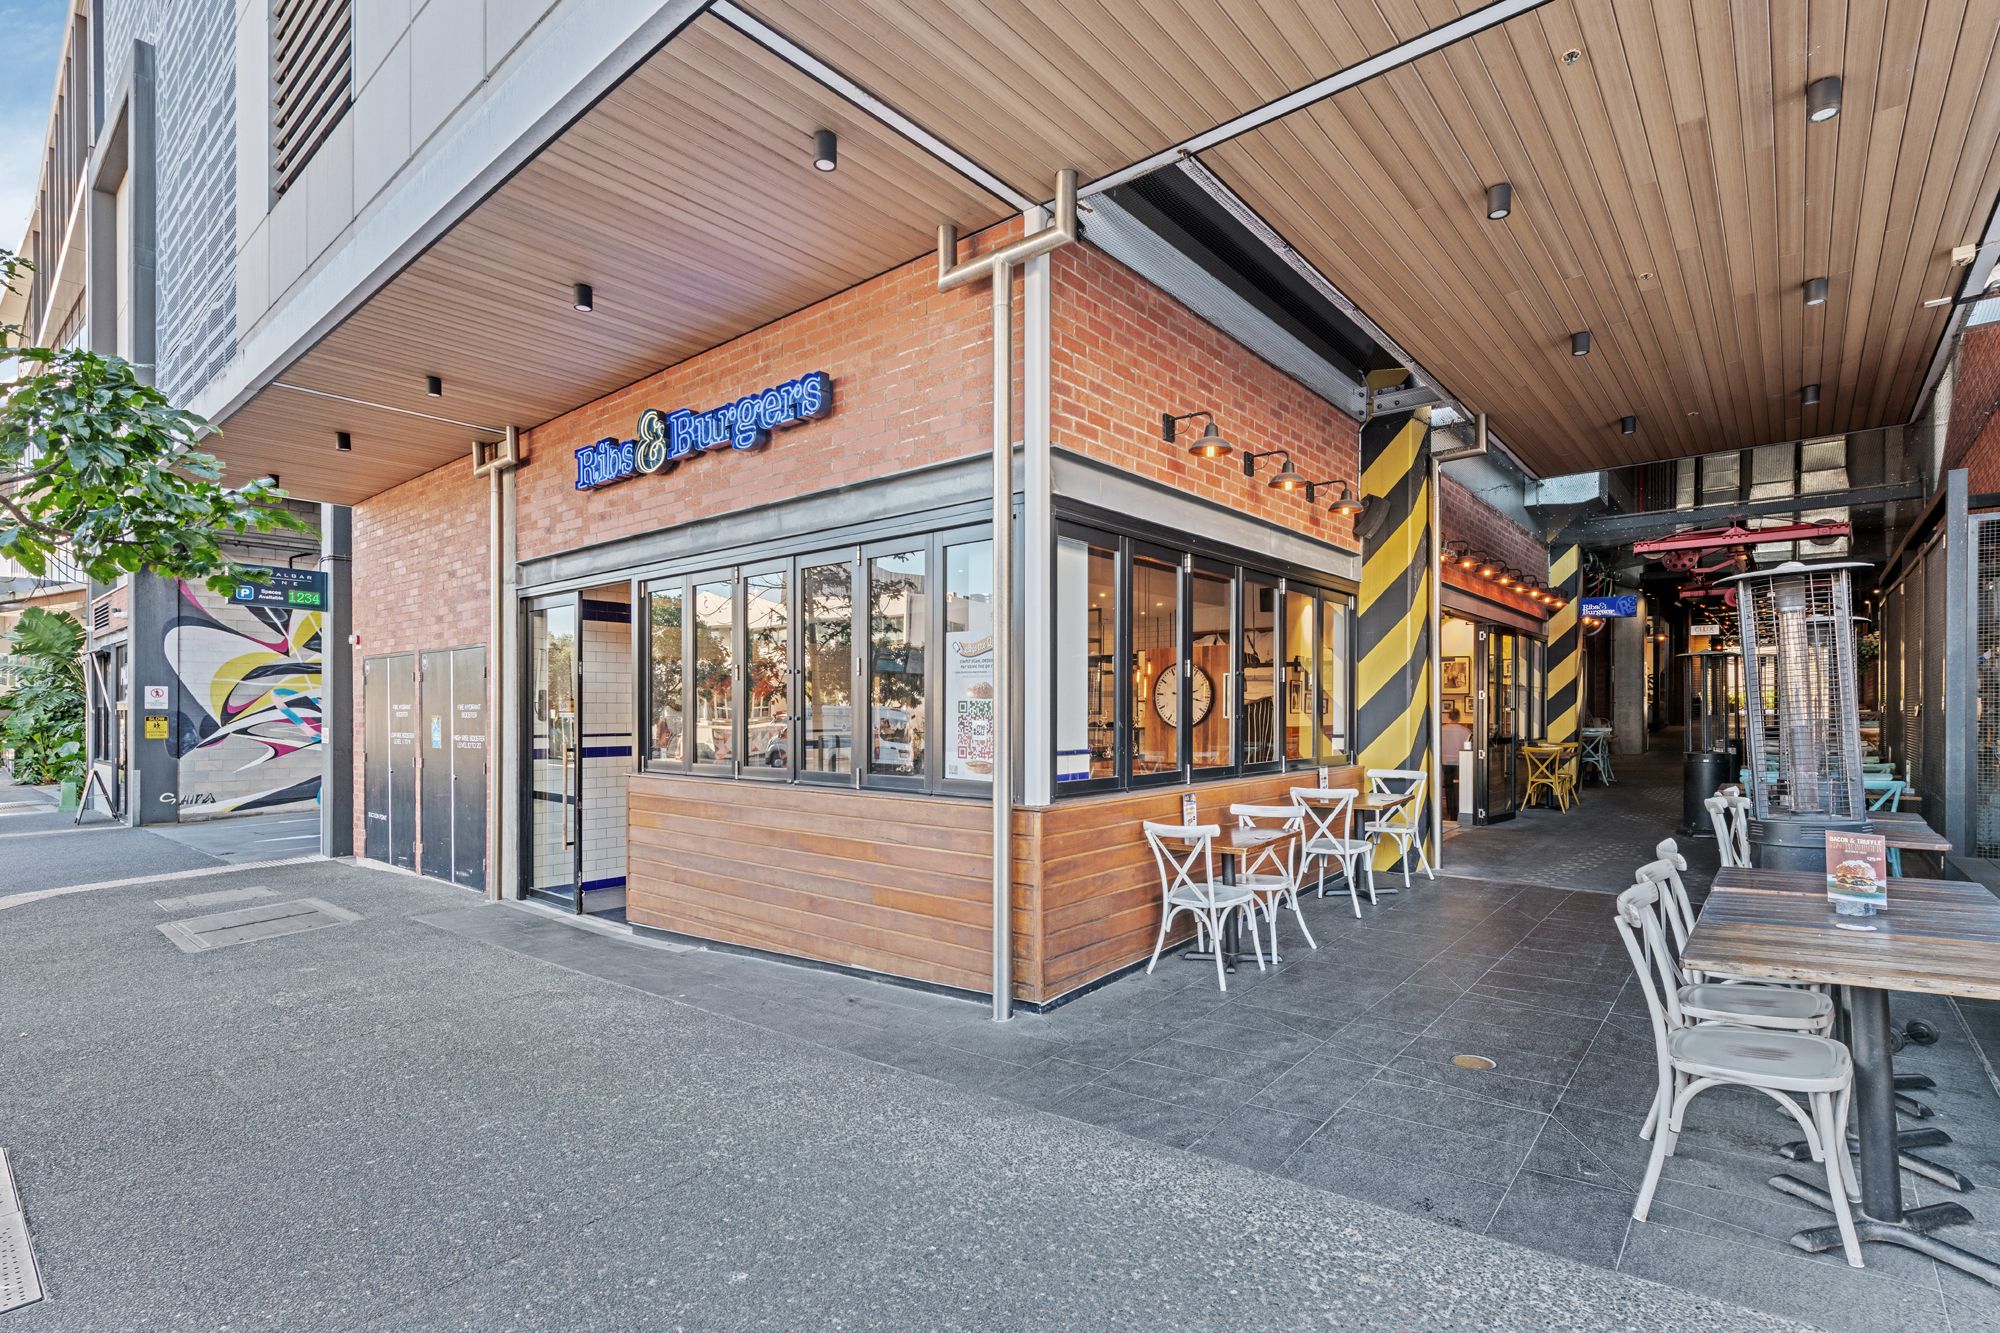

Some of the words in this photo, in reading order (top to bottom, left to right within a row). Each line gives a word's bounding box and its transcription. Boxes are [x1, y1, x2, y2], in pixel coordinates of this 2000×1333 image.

[575, 438, 636, 490] Ribs
[636, 408, 667, 474] &
[667, 371, 824, 459] Burgers
[261, 588, 282, 596] Spaces
[258, 594, 285, 602] Available
[289, 591, 320, 605] 1234
